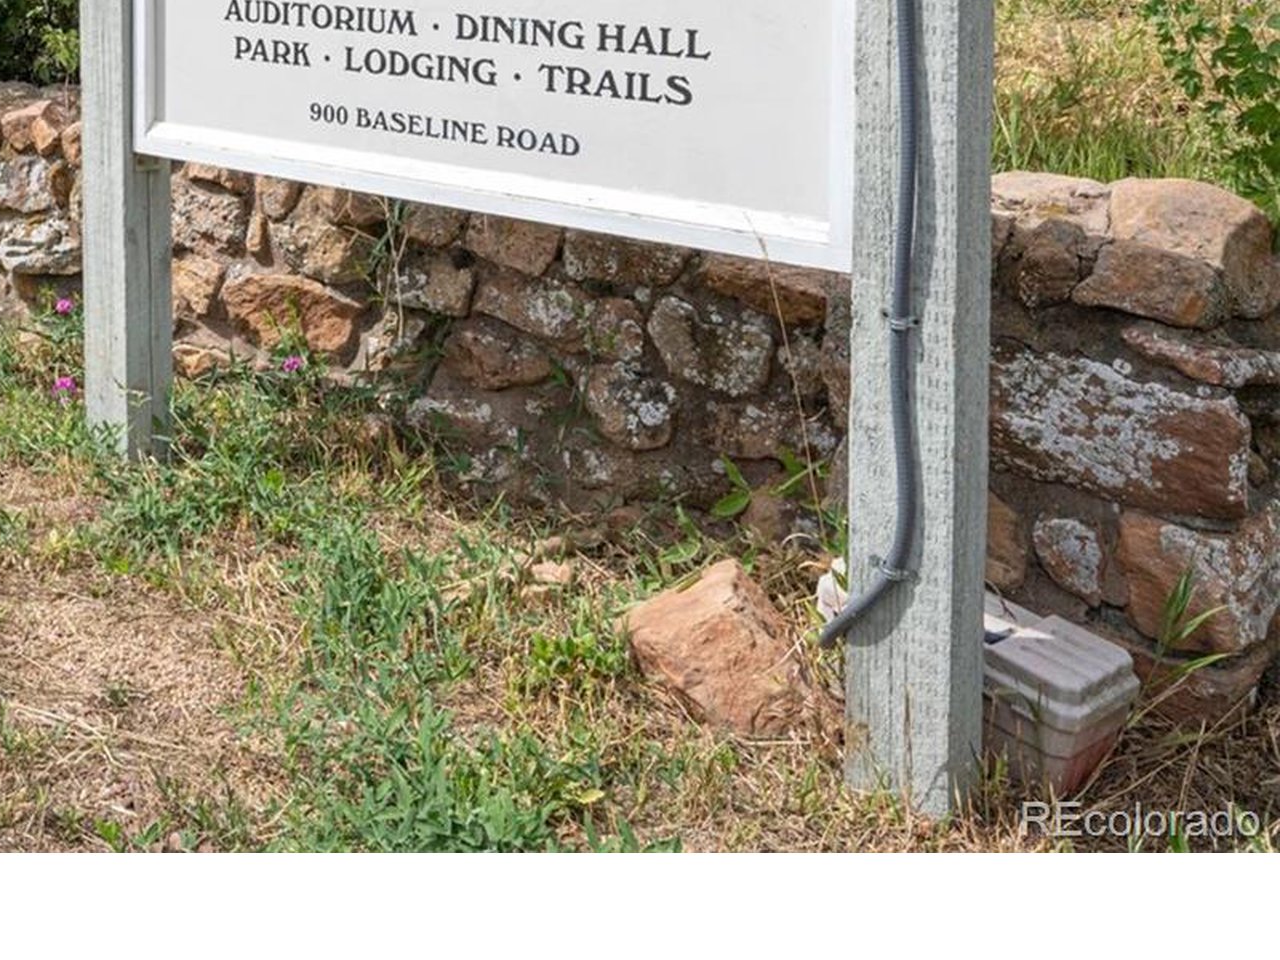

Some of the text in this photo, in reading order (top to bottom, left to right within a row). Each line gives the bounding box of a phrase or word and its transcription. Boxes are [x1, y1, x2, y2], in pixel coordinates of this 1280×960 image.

[455, 13, 585, 50] DINING
[596, 23, 711, 61] HALL
[234, 36, 693, 106] PARK LODGING TRAILS
[309, 102, 580, 156] 900 BASELINE ROAD
